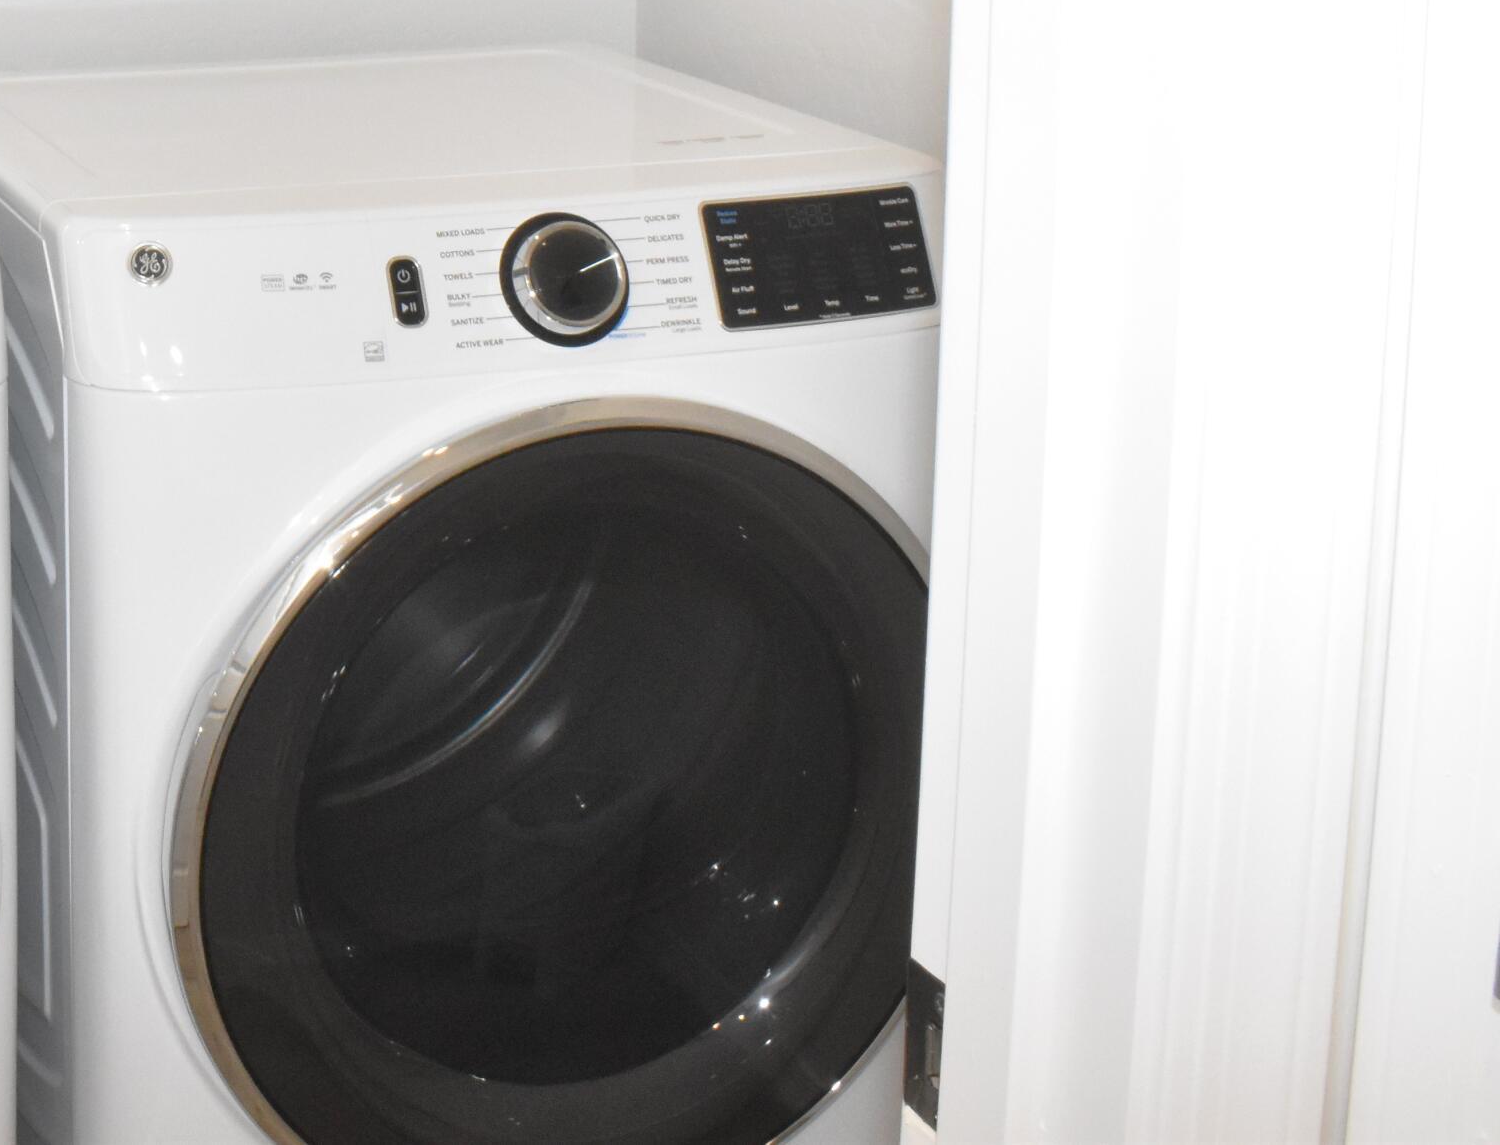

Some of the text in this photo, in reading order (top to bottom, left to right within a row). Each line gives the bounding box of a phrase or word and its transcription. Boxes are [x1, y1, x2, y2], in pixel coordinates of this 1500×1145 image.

[644, 213, 681, 223] QUICK DRY
[436, 228, 486, 238] MIXED LOADS
[647, 234, 684, 243] DELICATES
[440, 250, 475, 259] COTTONS
[646, 257, 665, 265] PERM
[444, 272, 473, 281] TOWELS
[666, 296, 698, 304] REFRESH
[451, 317, 484, 326] SANITIZE
[456, 340, 481, 349] ACTIVE
